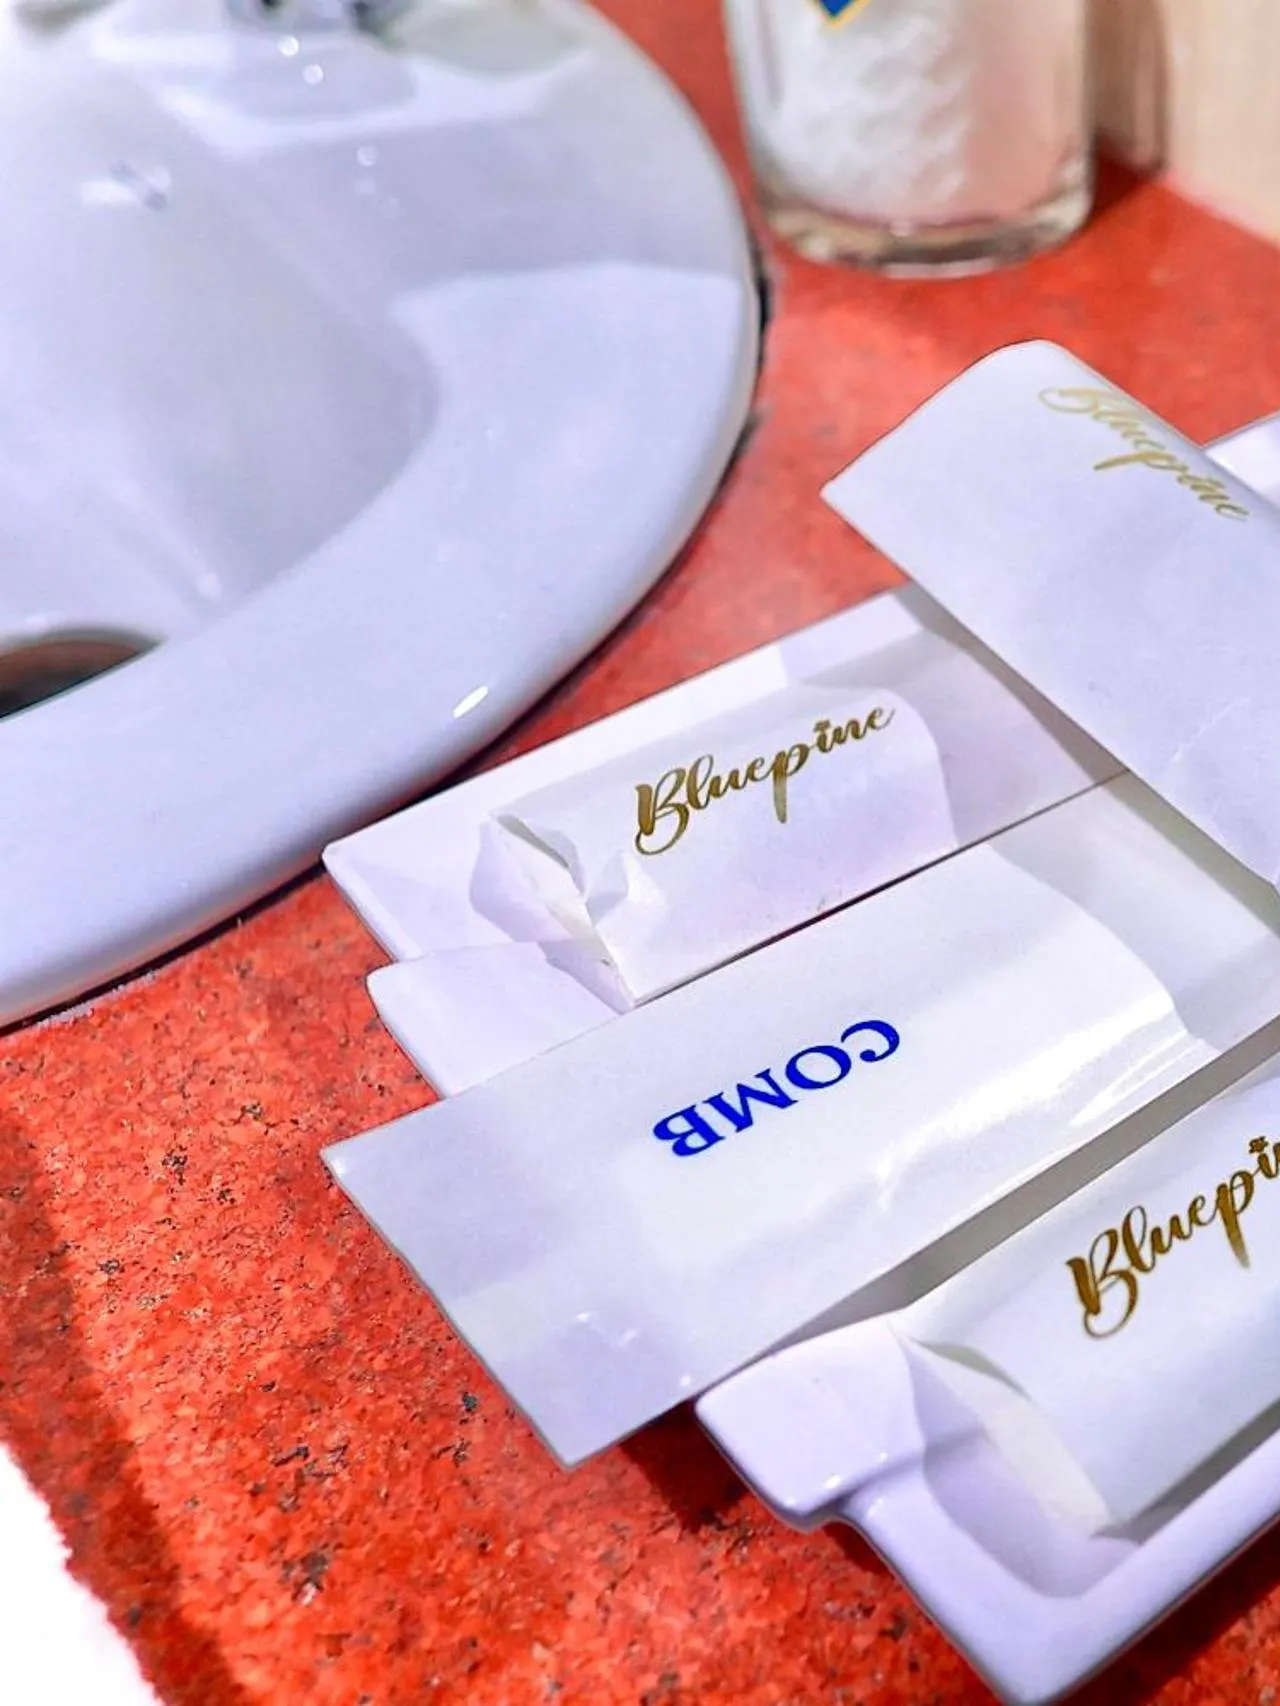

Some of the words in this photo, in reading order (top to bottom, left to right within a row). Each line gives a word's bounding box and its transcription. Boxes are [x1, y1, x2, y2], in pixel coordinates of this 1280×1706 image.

[1038, 386, 1249, 521] Bluepine
[635, 707, 896, 855] Bluepine
[653, 1020, 900, 1156] COMB
